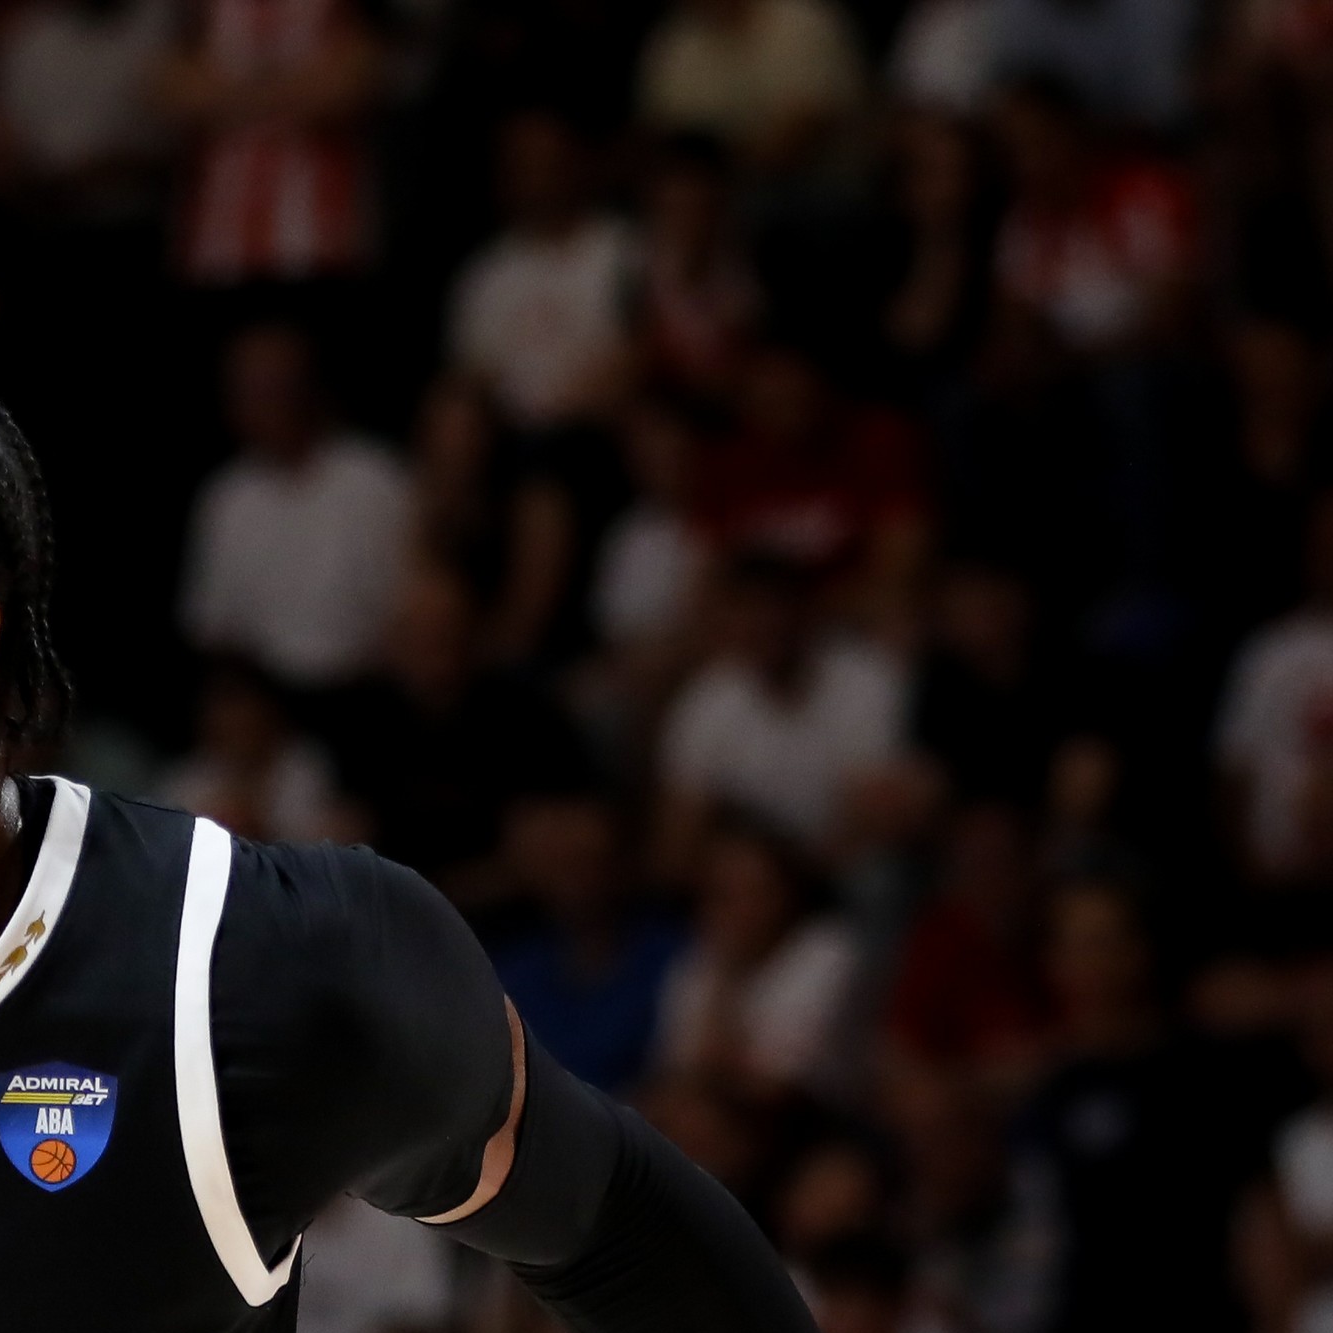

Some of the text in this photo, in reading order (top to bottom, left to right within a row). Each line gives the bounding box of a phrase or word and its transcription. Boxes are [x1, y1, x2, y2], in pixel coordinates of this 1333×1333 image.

[7, 1075, 109, 1093] ADMIRAL
[71, 1094, 108, 1106] BET
[35, 1107, 74, 1135] ABA
